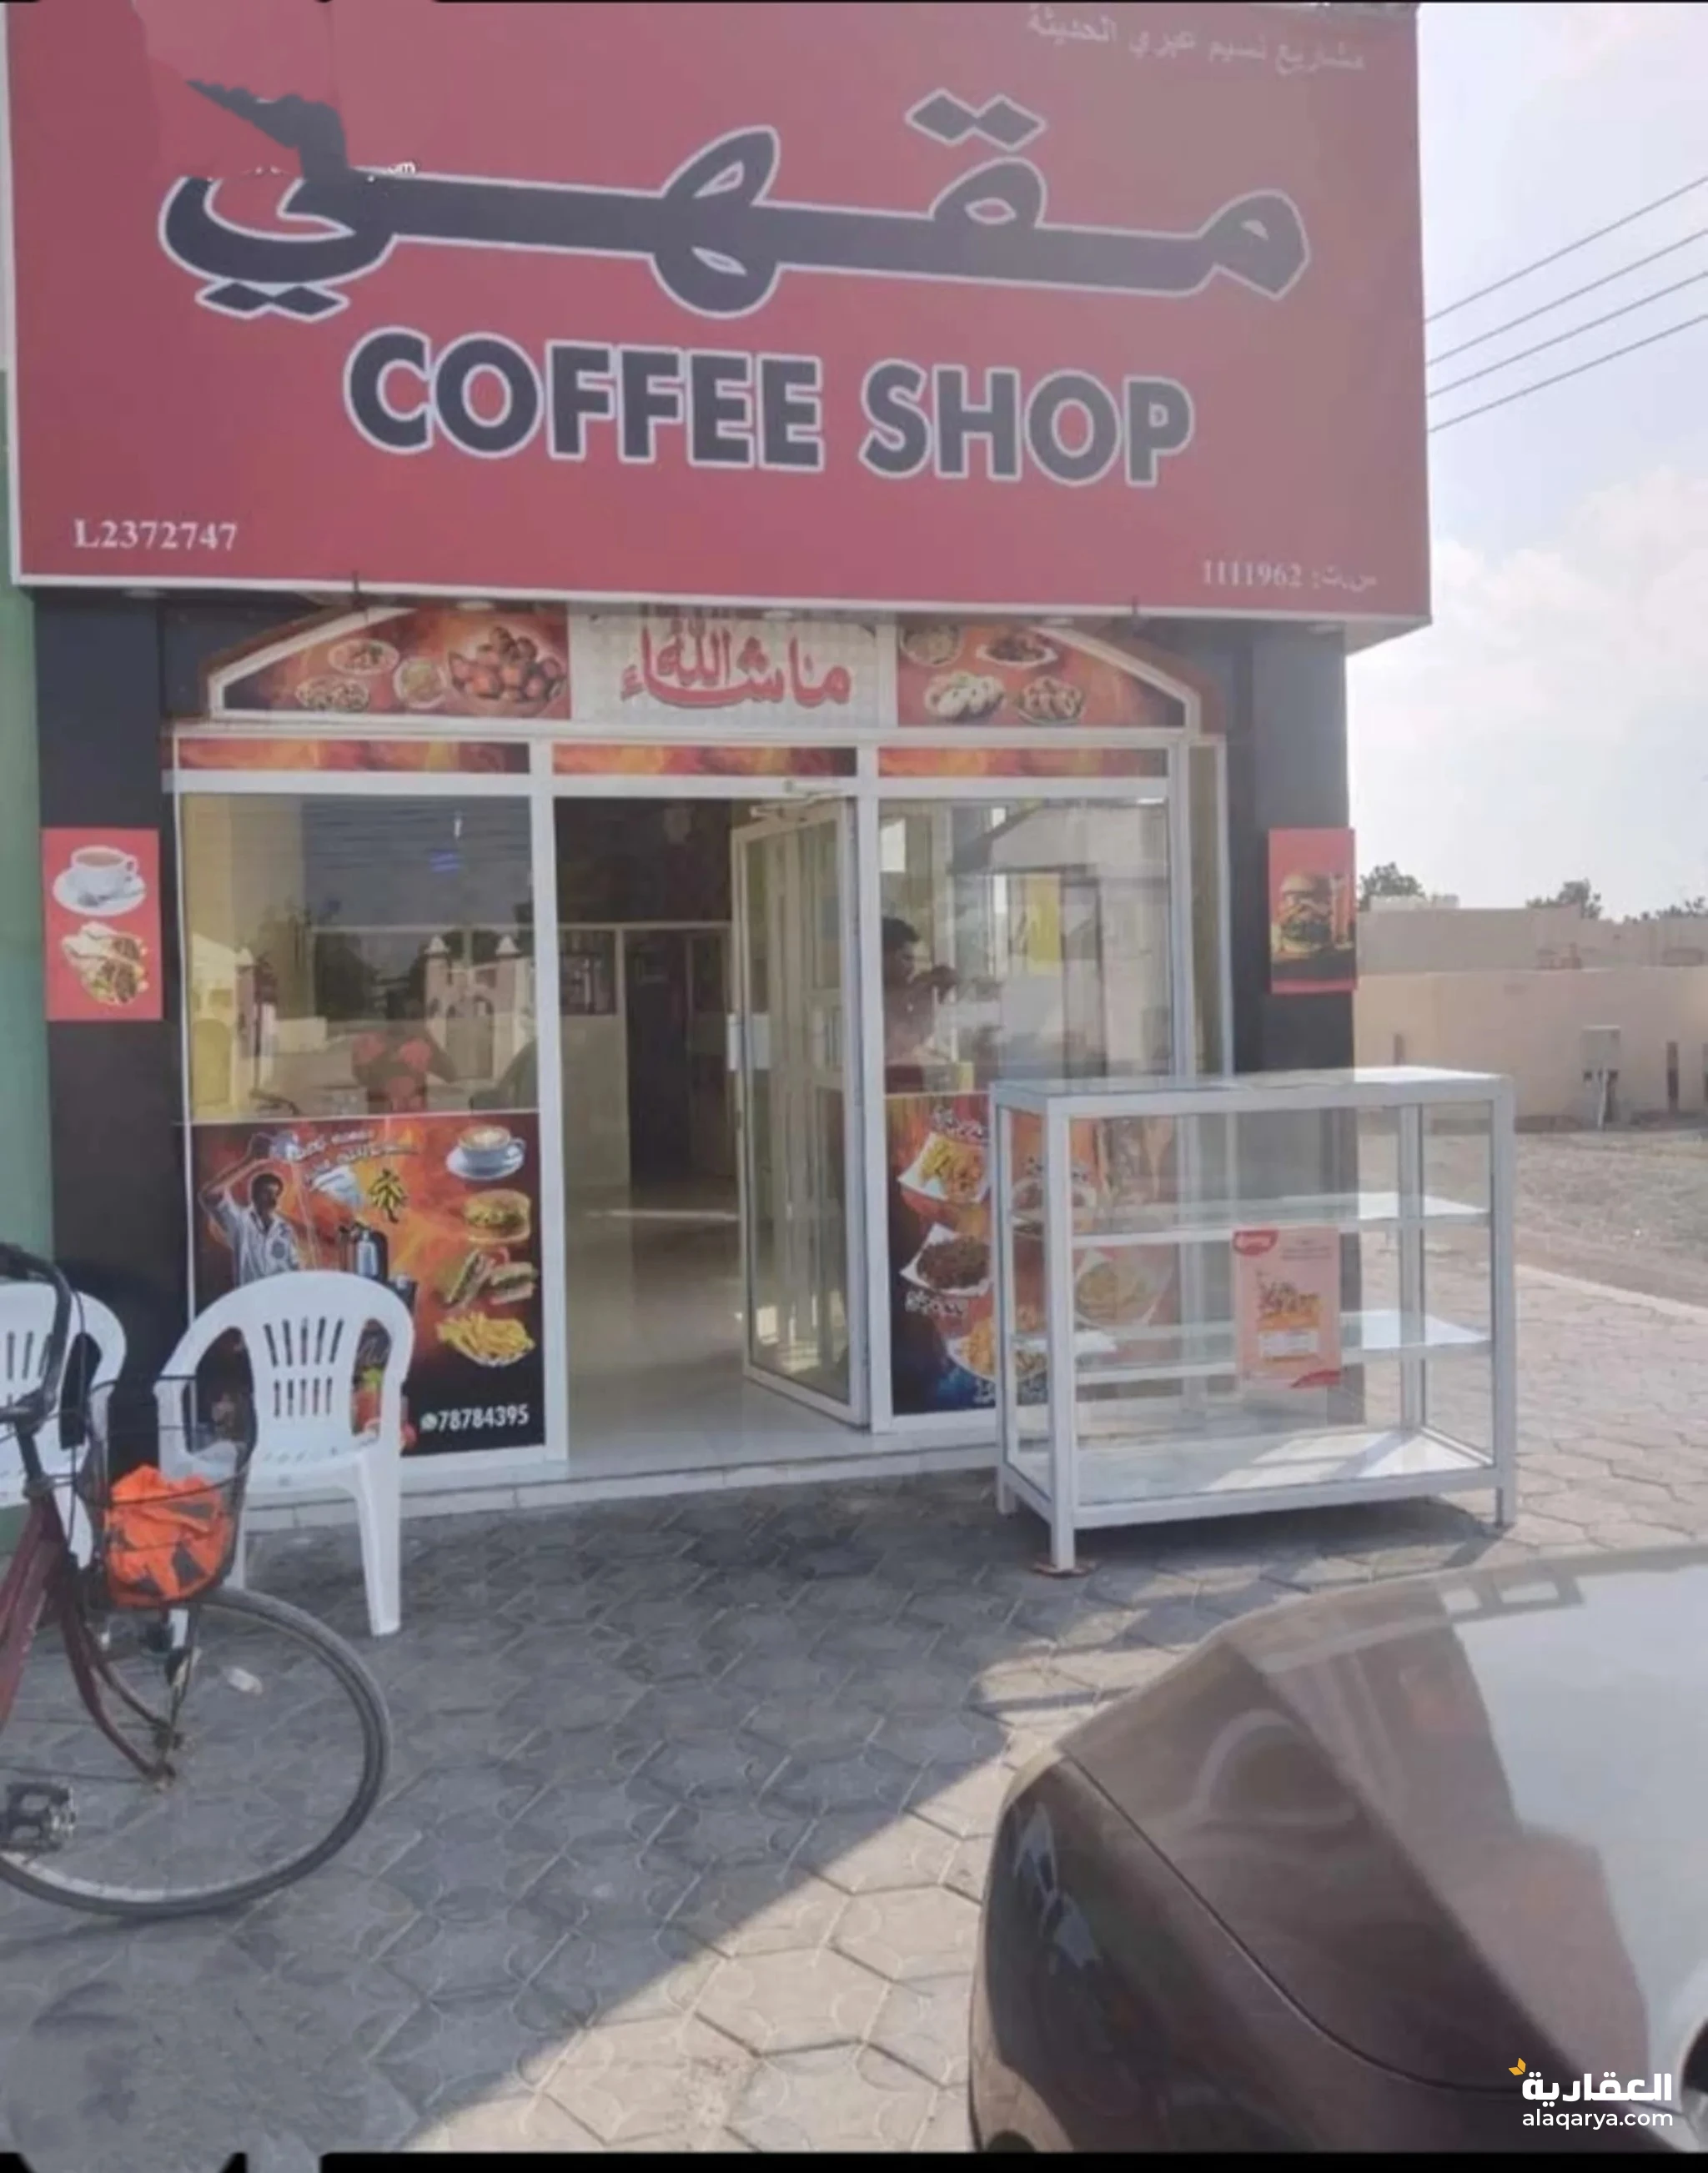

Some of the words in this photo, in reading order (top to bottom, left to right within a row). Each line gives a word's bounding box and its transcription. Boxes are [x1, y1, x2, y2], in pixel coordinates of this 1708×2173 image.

[343, 325, 825, 474] COFFEE
[858, 357, 1196, 488] SHOP
[74, 519, 239, 550] L2372747
[1203, 560, 1302, 589] 1111962
[438, 1403, 530, 1433] 78784395
